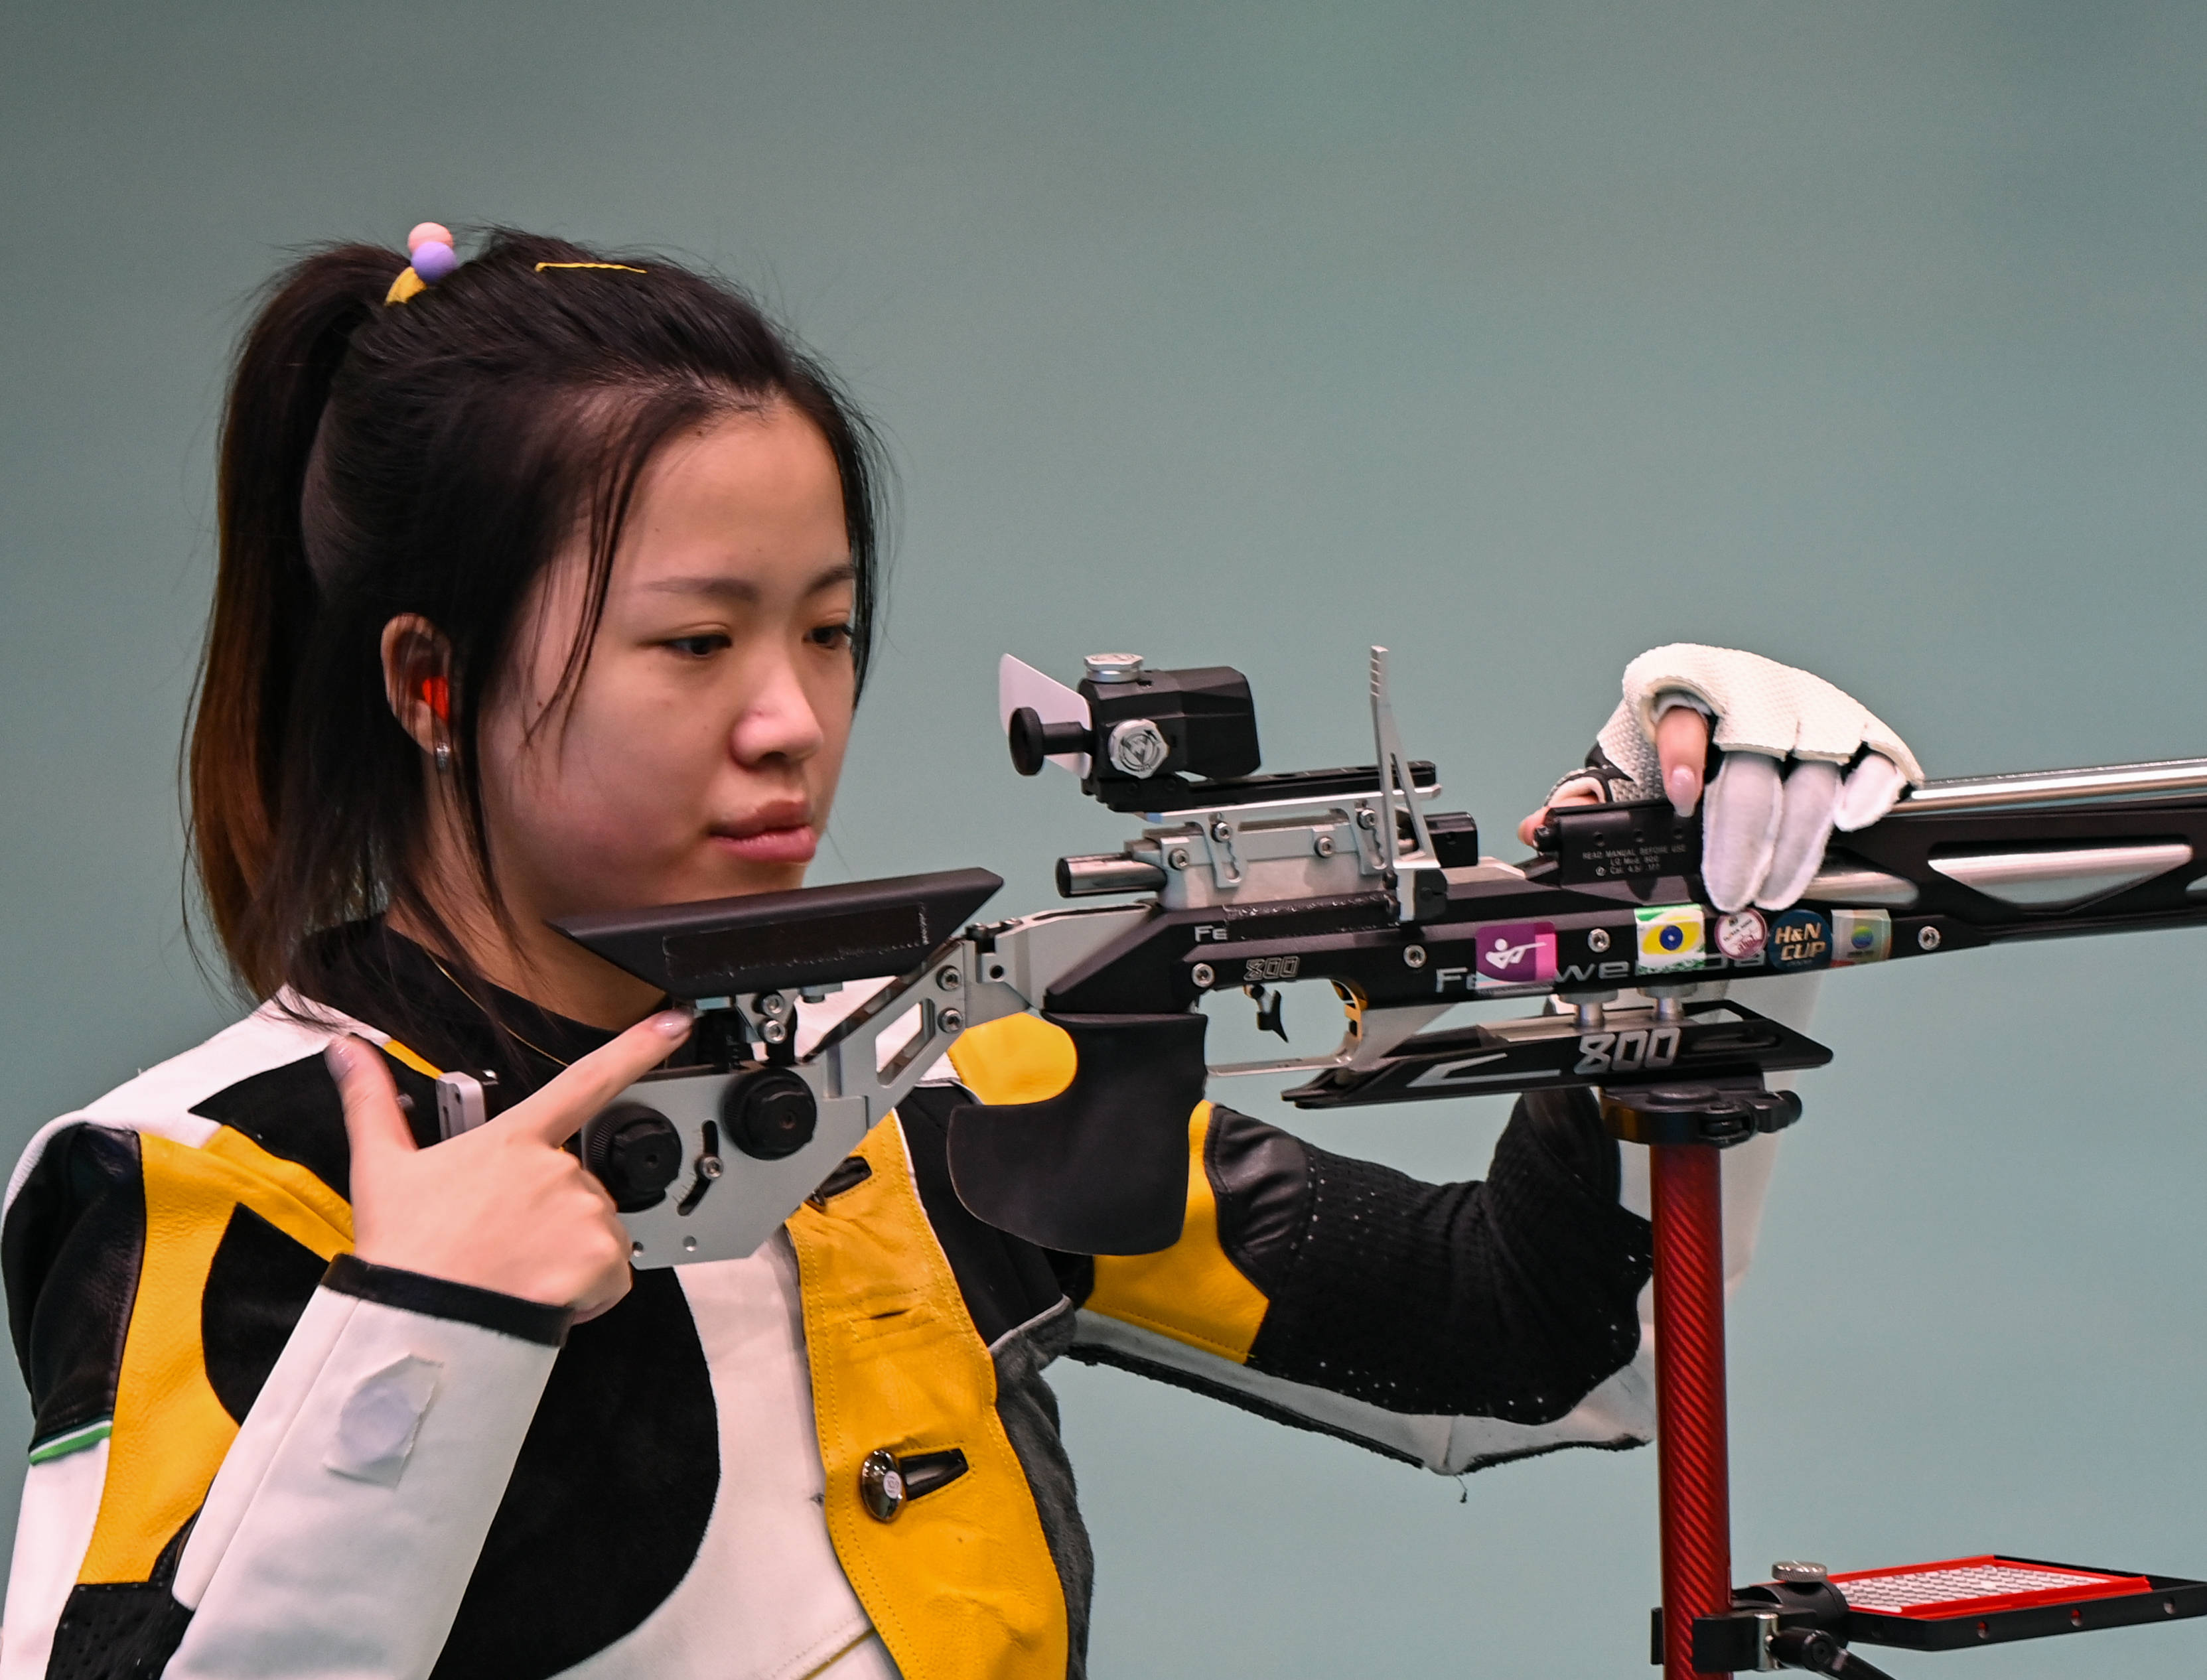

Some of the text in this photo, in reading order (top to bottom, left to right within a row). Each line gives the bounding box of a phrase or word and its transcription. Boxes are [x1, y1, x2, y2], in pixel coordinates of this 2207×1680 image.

[1605, 848, 1636, 858] MANUAL
[1774, 922, 1821, 944] H&N
[1781, 941, 1827, 961] CUP
[1244, 955, 1300, 981] 800
[1573, 1026, 1681, 1076] 800
